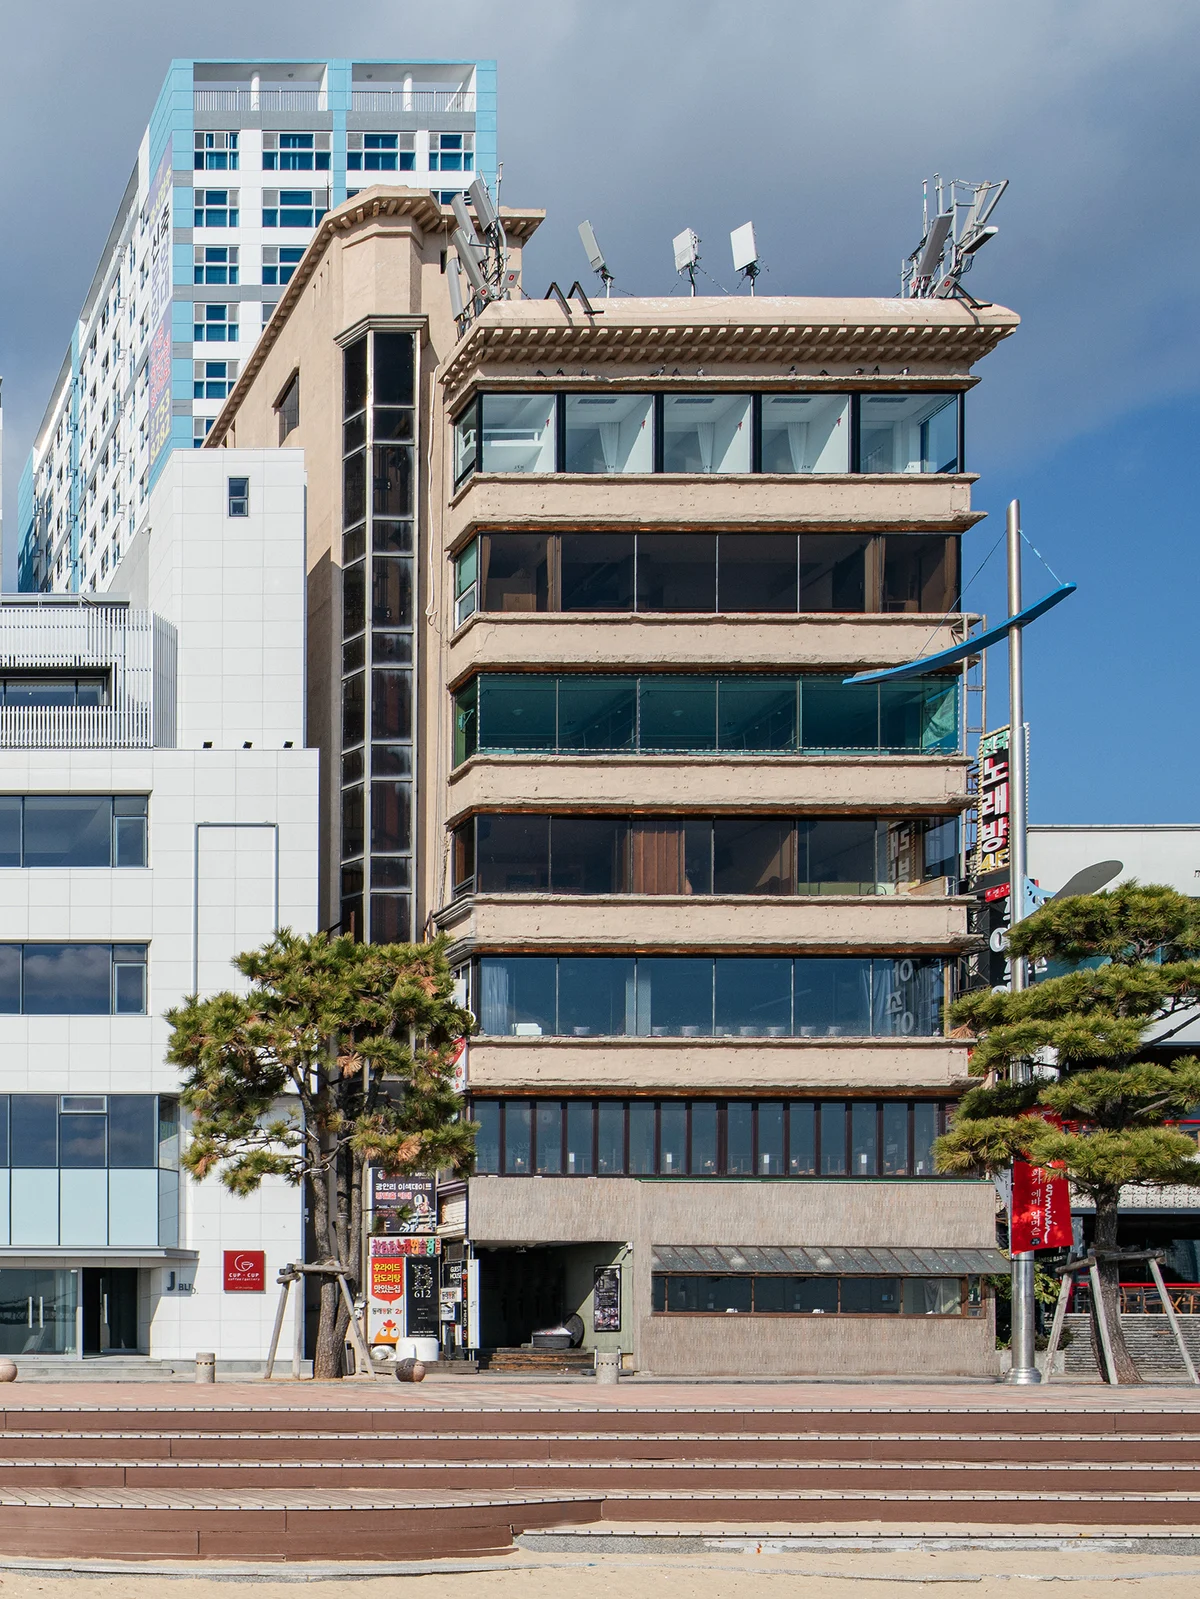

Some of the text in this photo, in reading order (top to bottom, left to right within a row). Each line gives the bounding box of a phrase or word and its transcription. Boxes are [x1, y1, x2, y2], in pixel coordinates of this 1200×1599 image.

[981, 757, 1009, 853] 노래방
[981, 849, 1008, 871] 4F
[374, 1263, 401, 1272] 후라이드
[166, 1271, 176, 1292] J
[374, 1274, 401, 1283] 닭도리탕
[374, 1285, 401, 1294] 맛있는집
[414, 1290, 431, 1298] 612
